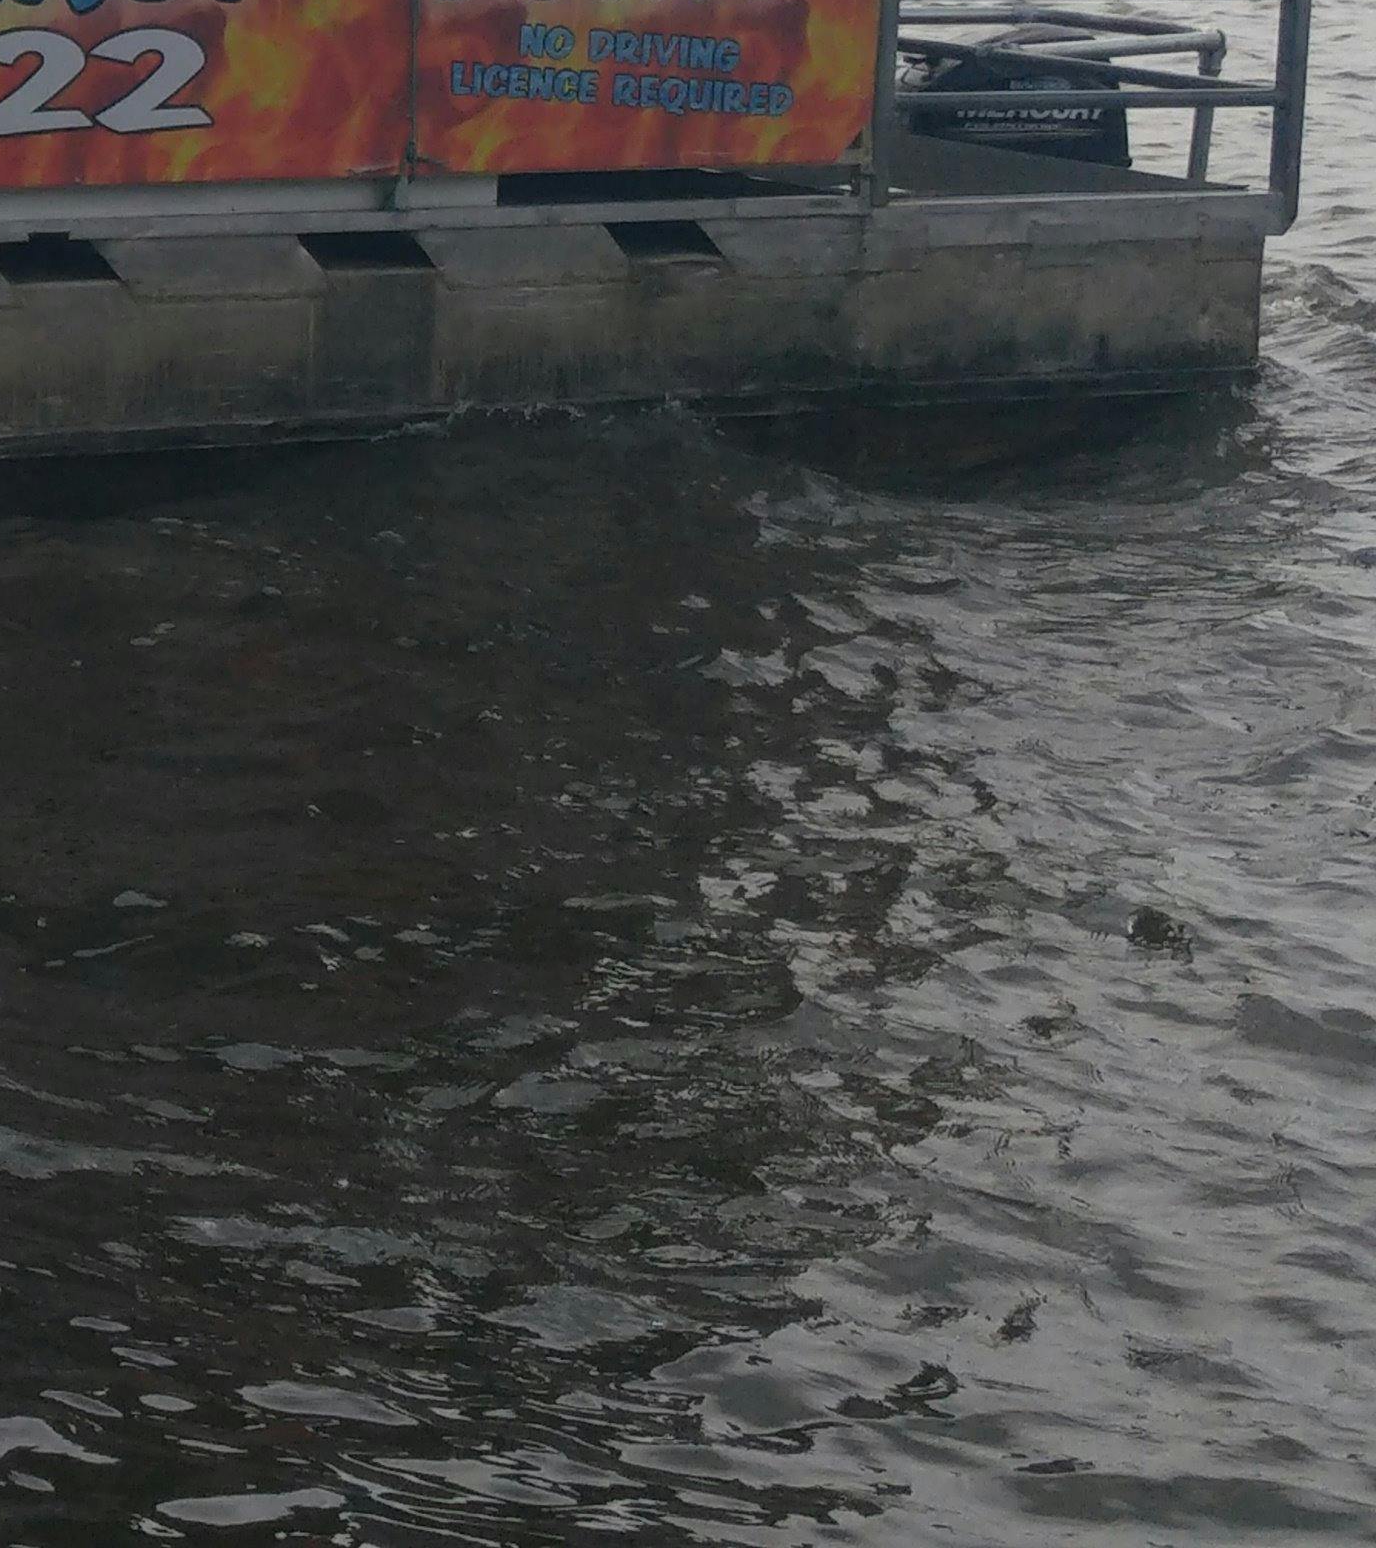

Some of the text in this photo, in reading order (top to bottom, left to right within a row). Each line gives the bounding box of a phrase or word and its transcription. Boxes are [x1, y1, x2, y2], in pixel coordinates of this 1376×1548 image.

[519, 23, 742, 74] NO DRIVING
[450, 61, 794, 117] LICENCE REQUIRED
